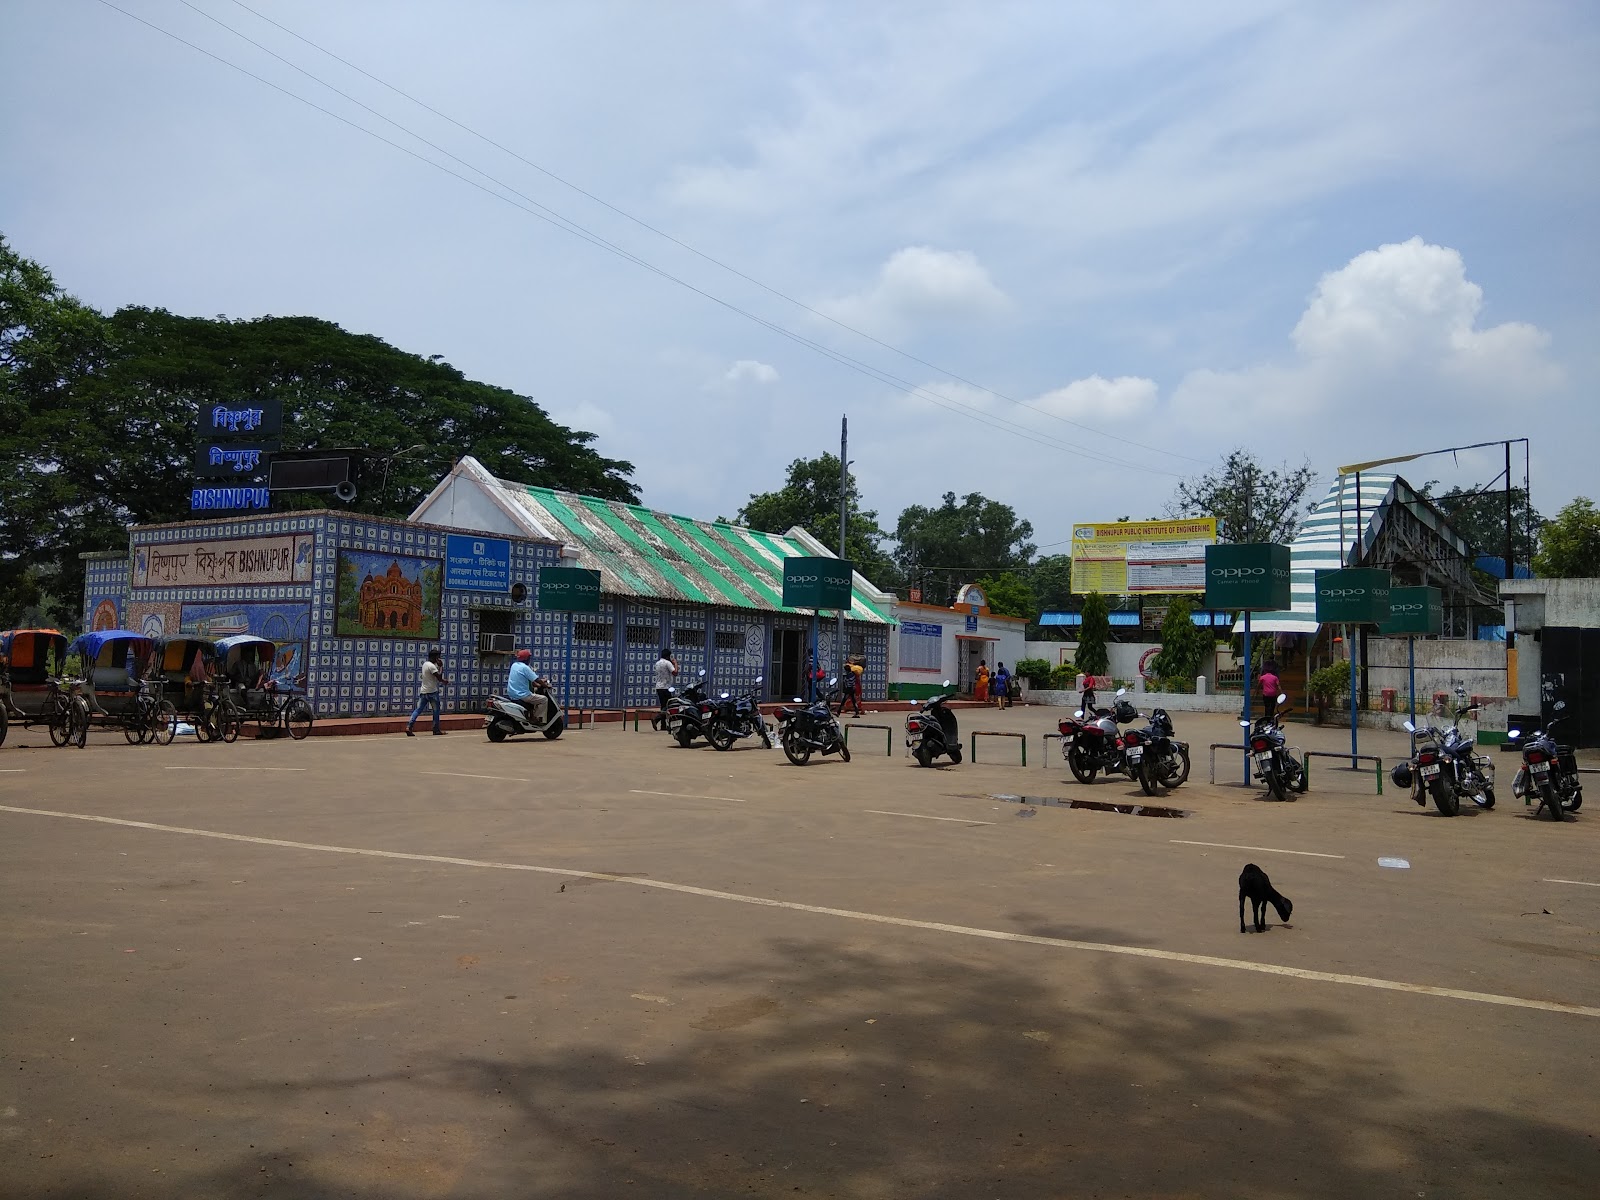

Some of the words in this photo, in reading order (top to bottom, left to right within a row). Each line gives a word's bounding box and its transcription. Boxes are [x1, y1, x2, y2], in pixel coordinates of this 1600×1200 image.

[212, 405, 263, 431] বিষ্ণুপুর
[192, 487, 270, 510] BISHNUPUR
[1097, 526, 1123, 537] BISHNUPUR
[1124, 527, 1142, 535] PUBLIC
[1142, 526, 1168, 535] INSTITUTE
[1176, 525, 1210, 534] ENGINEERING
[239, 547, 290, 574] BISHNUPUR
[1390, 603, 1423, 612] ppo
